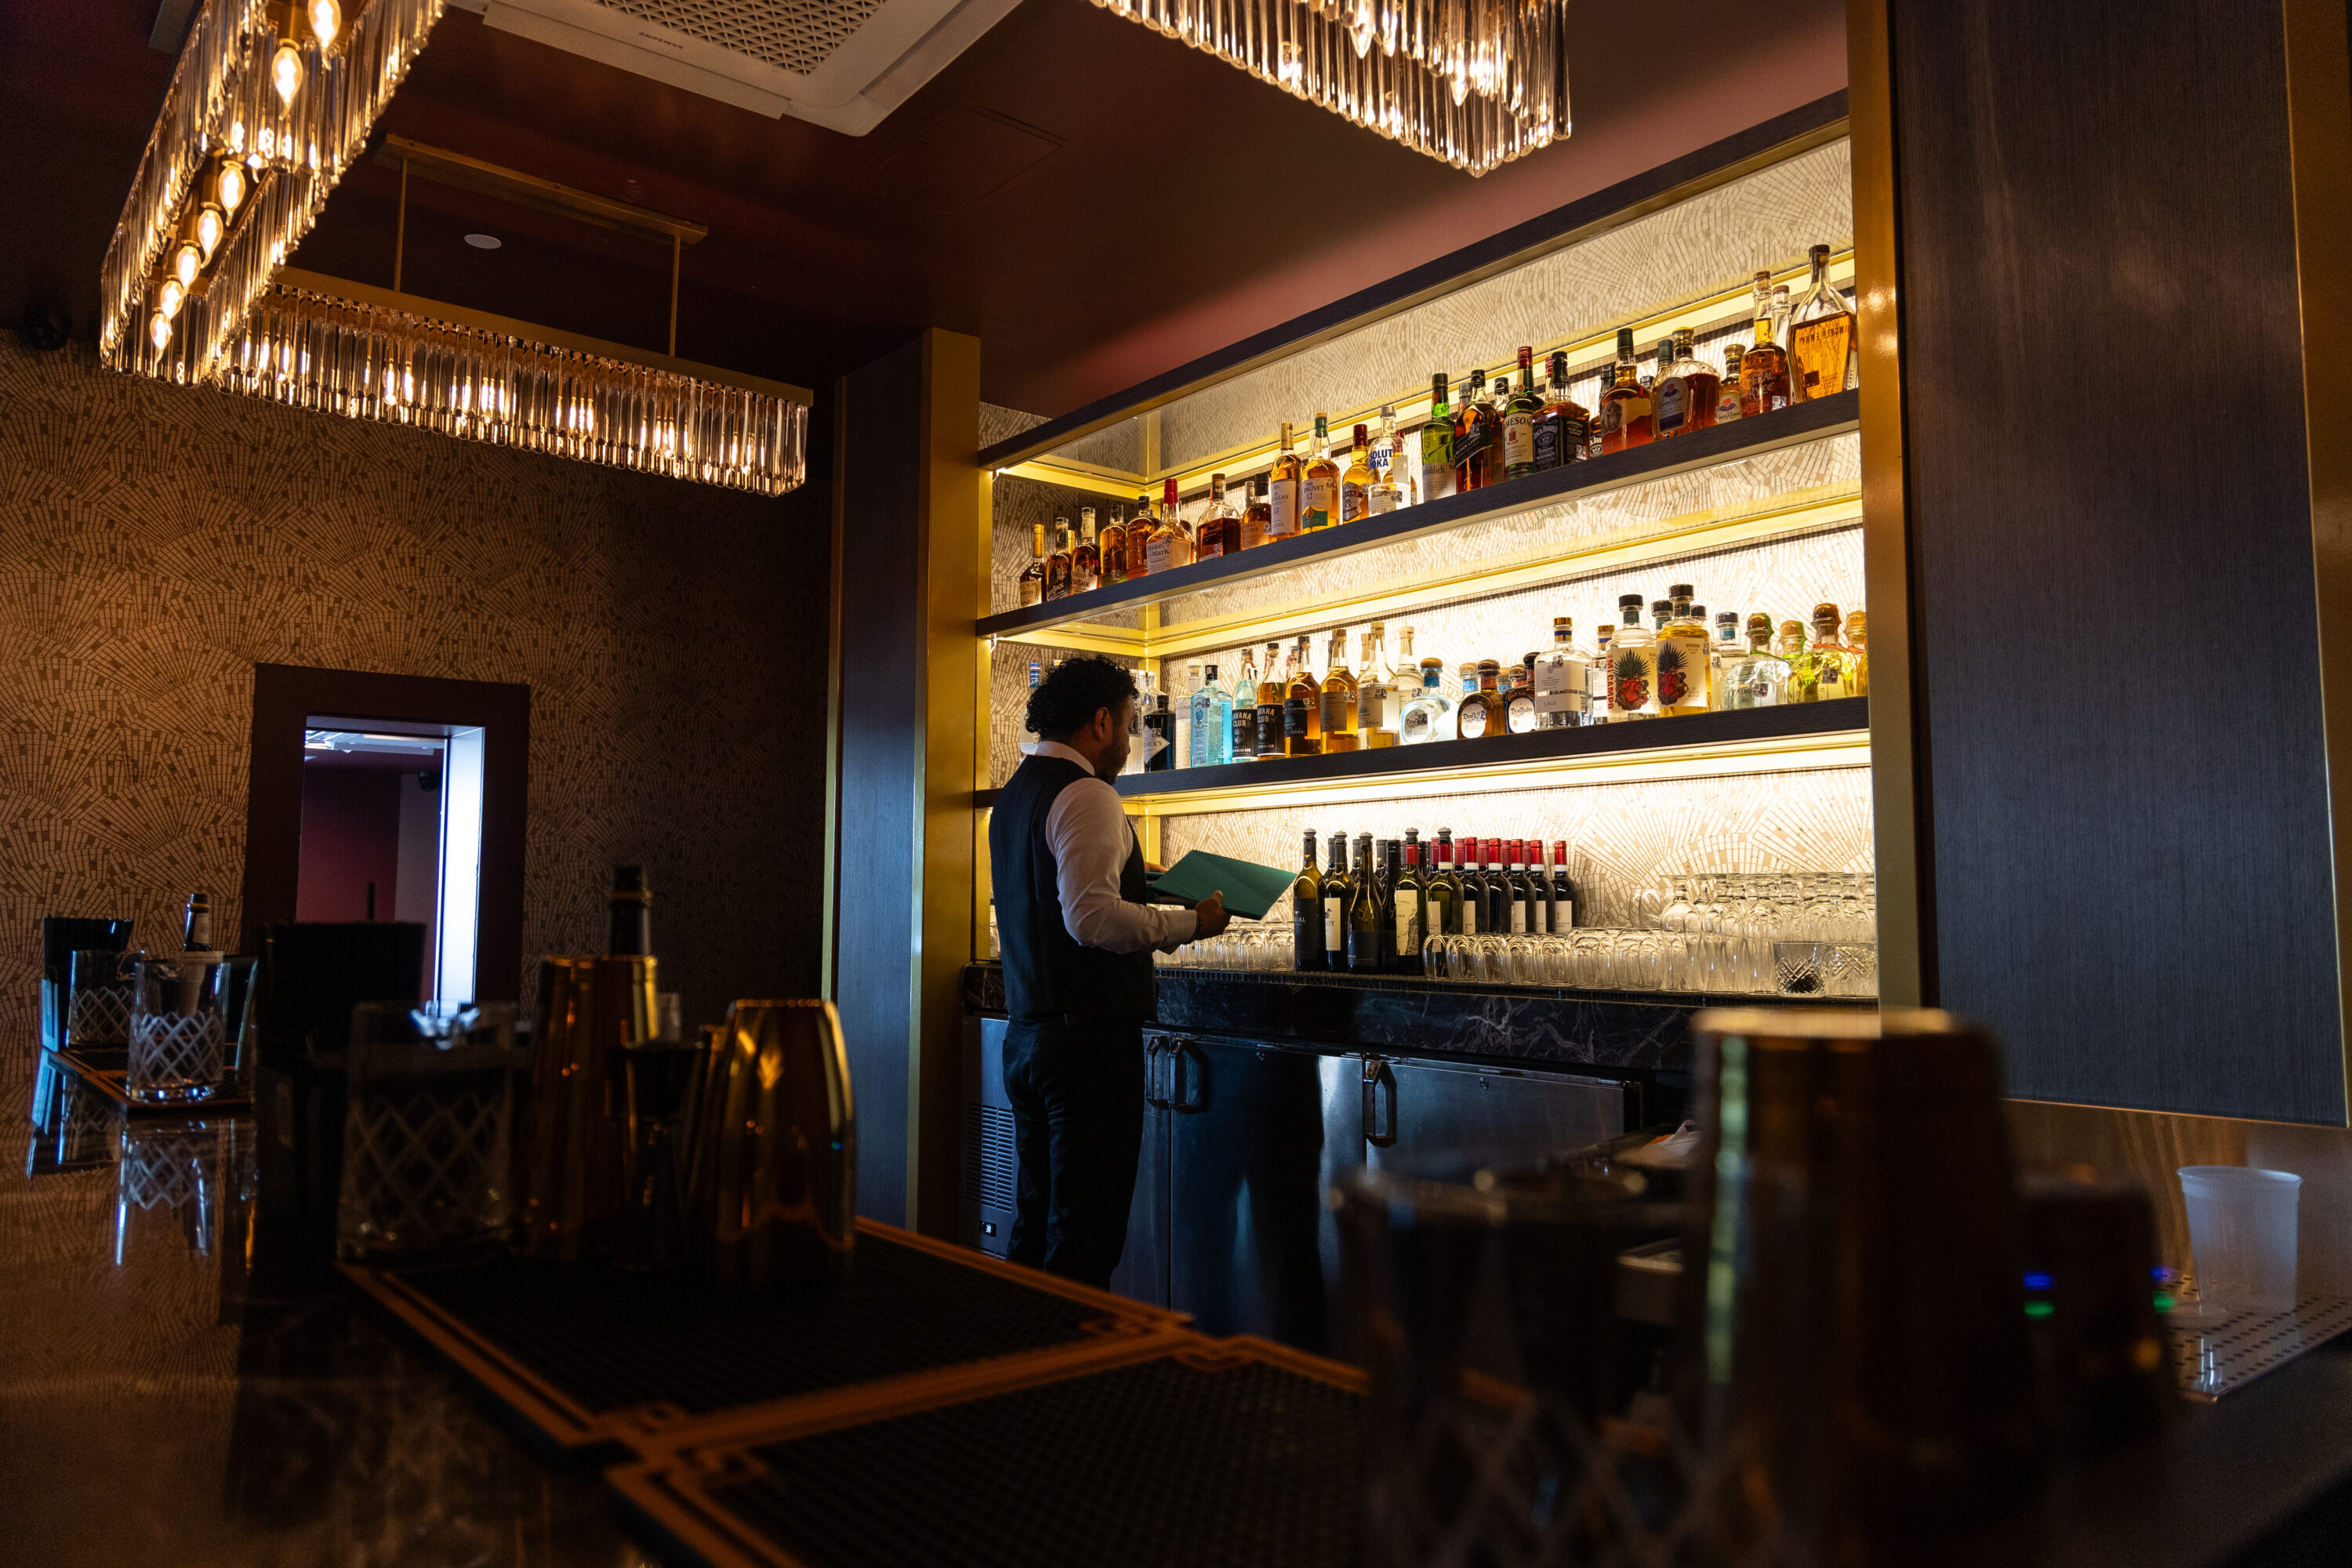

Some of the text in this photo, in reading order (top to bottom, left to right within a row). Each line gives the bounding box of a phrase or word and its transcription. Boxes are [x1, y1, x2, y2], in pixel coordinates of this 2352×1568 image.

[639, 31, 684, 49] SAMSUNG
[1370, 448, 1393, 461] SOLUT
[1152, 548, 1170, 557] Mark
[1077, 579, 1091, 587] BACK
[1232, 712, 1252, 720] AVANA
[1232, 719, 1247, 728] CLUB
